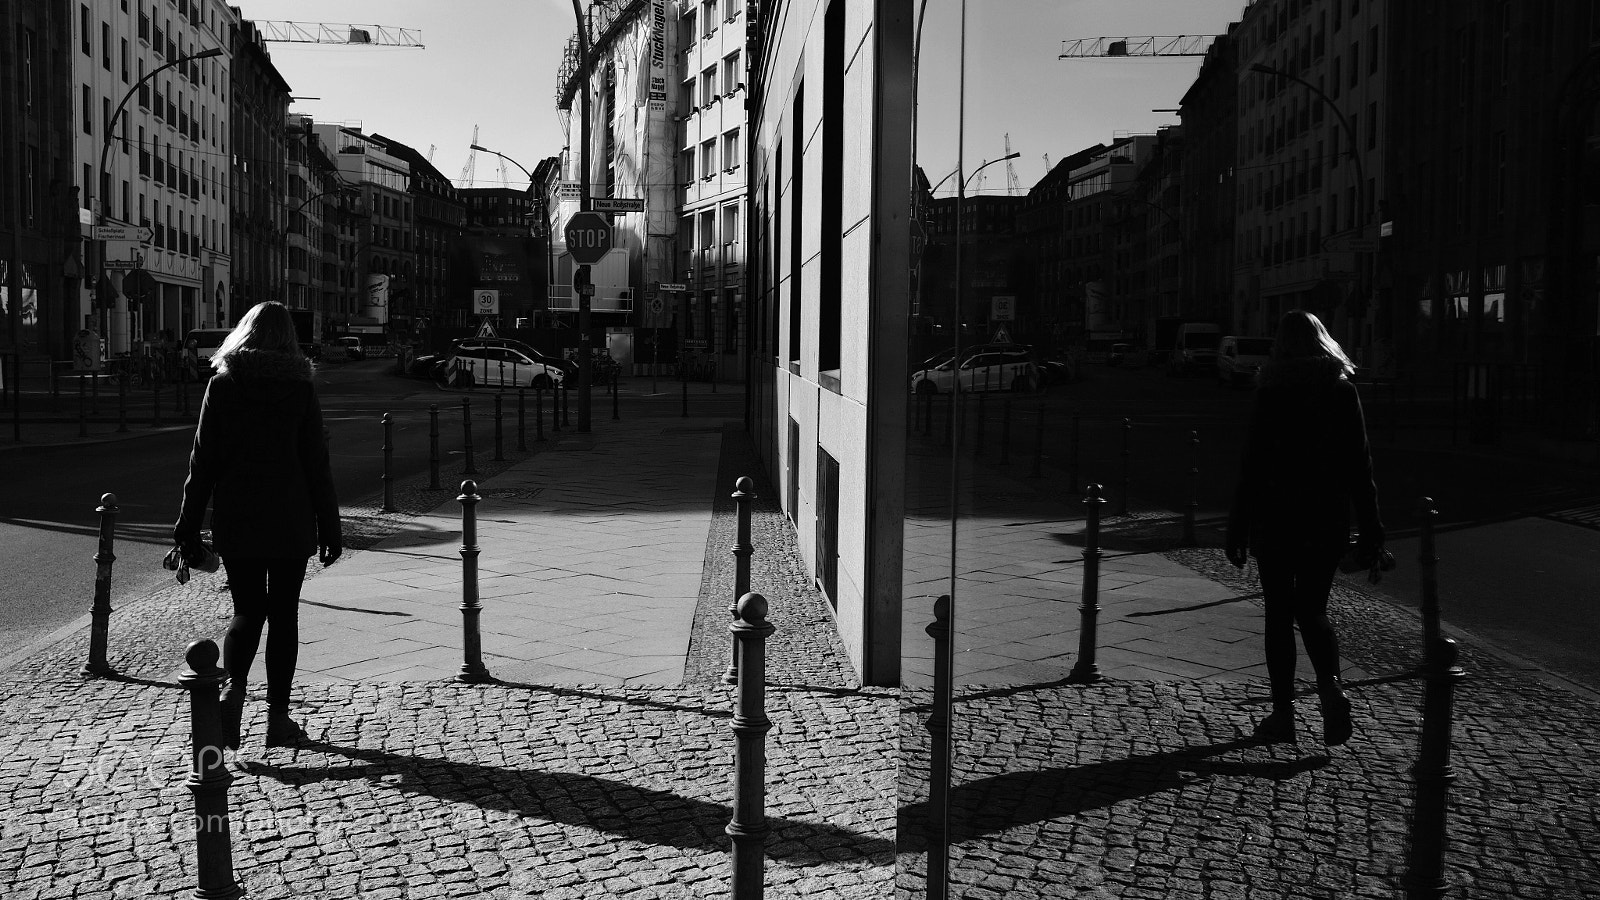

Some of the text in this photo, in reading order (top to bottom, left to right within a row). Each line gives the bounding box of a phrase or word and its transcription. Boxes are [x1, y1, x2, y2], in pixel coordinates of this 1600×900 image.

[596, 200, 611, 208] Neue
[569, 229, 607, 248] STOP
[481, 295, 492, 303] 30
